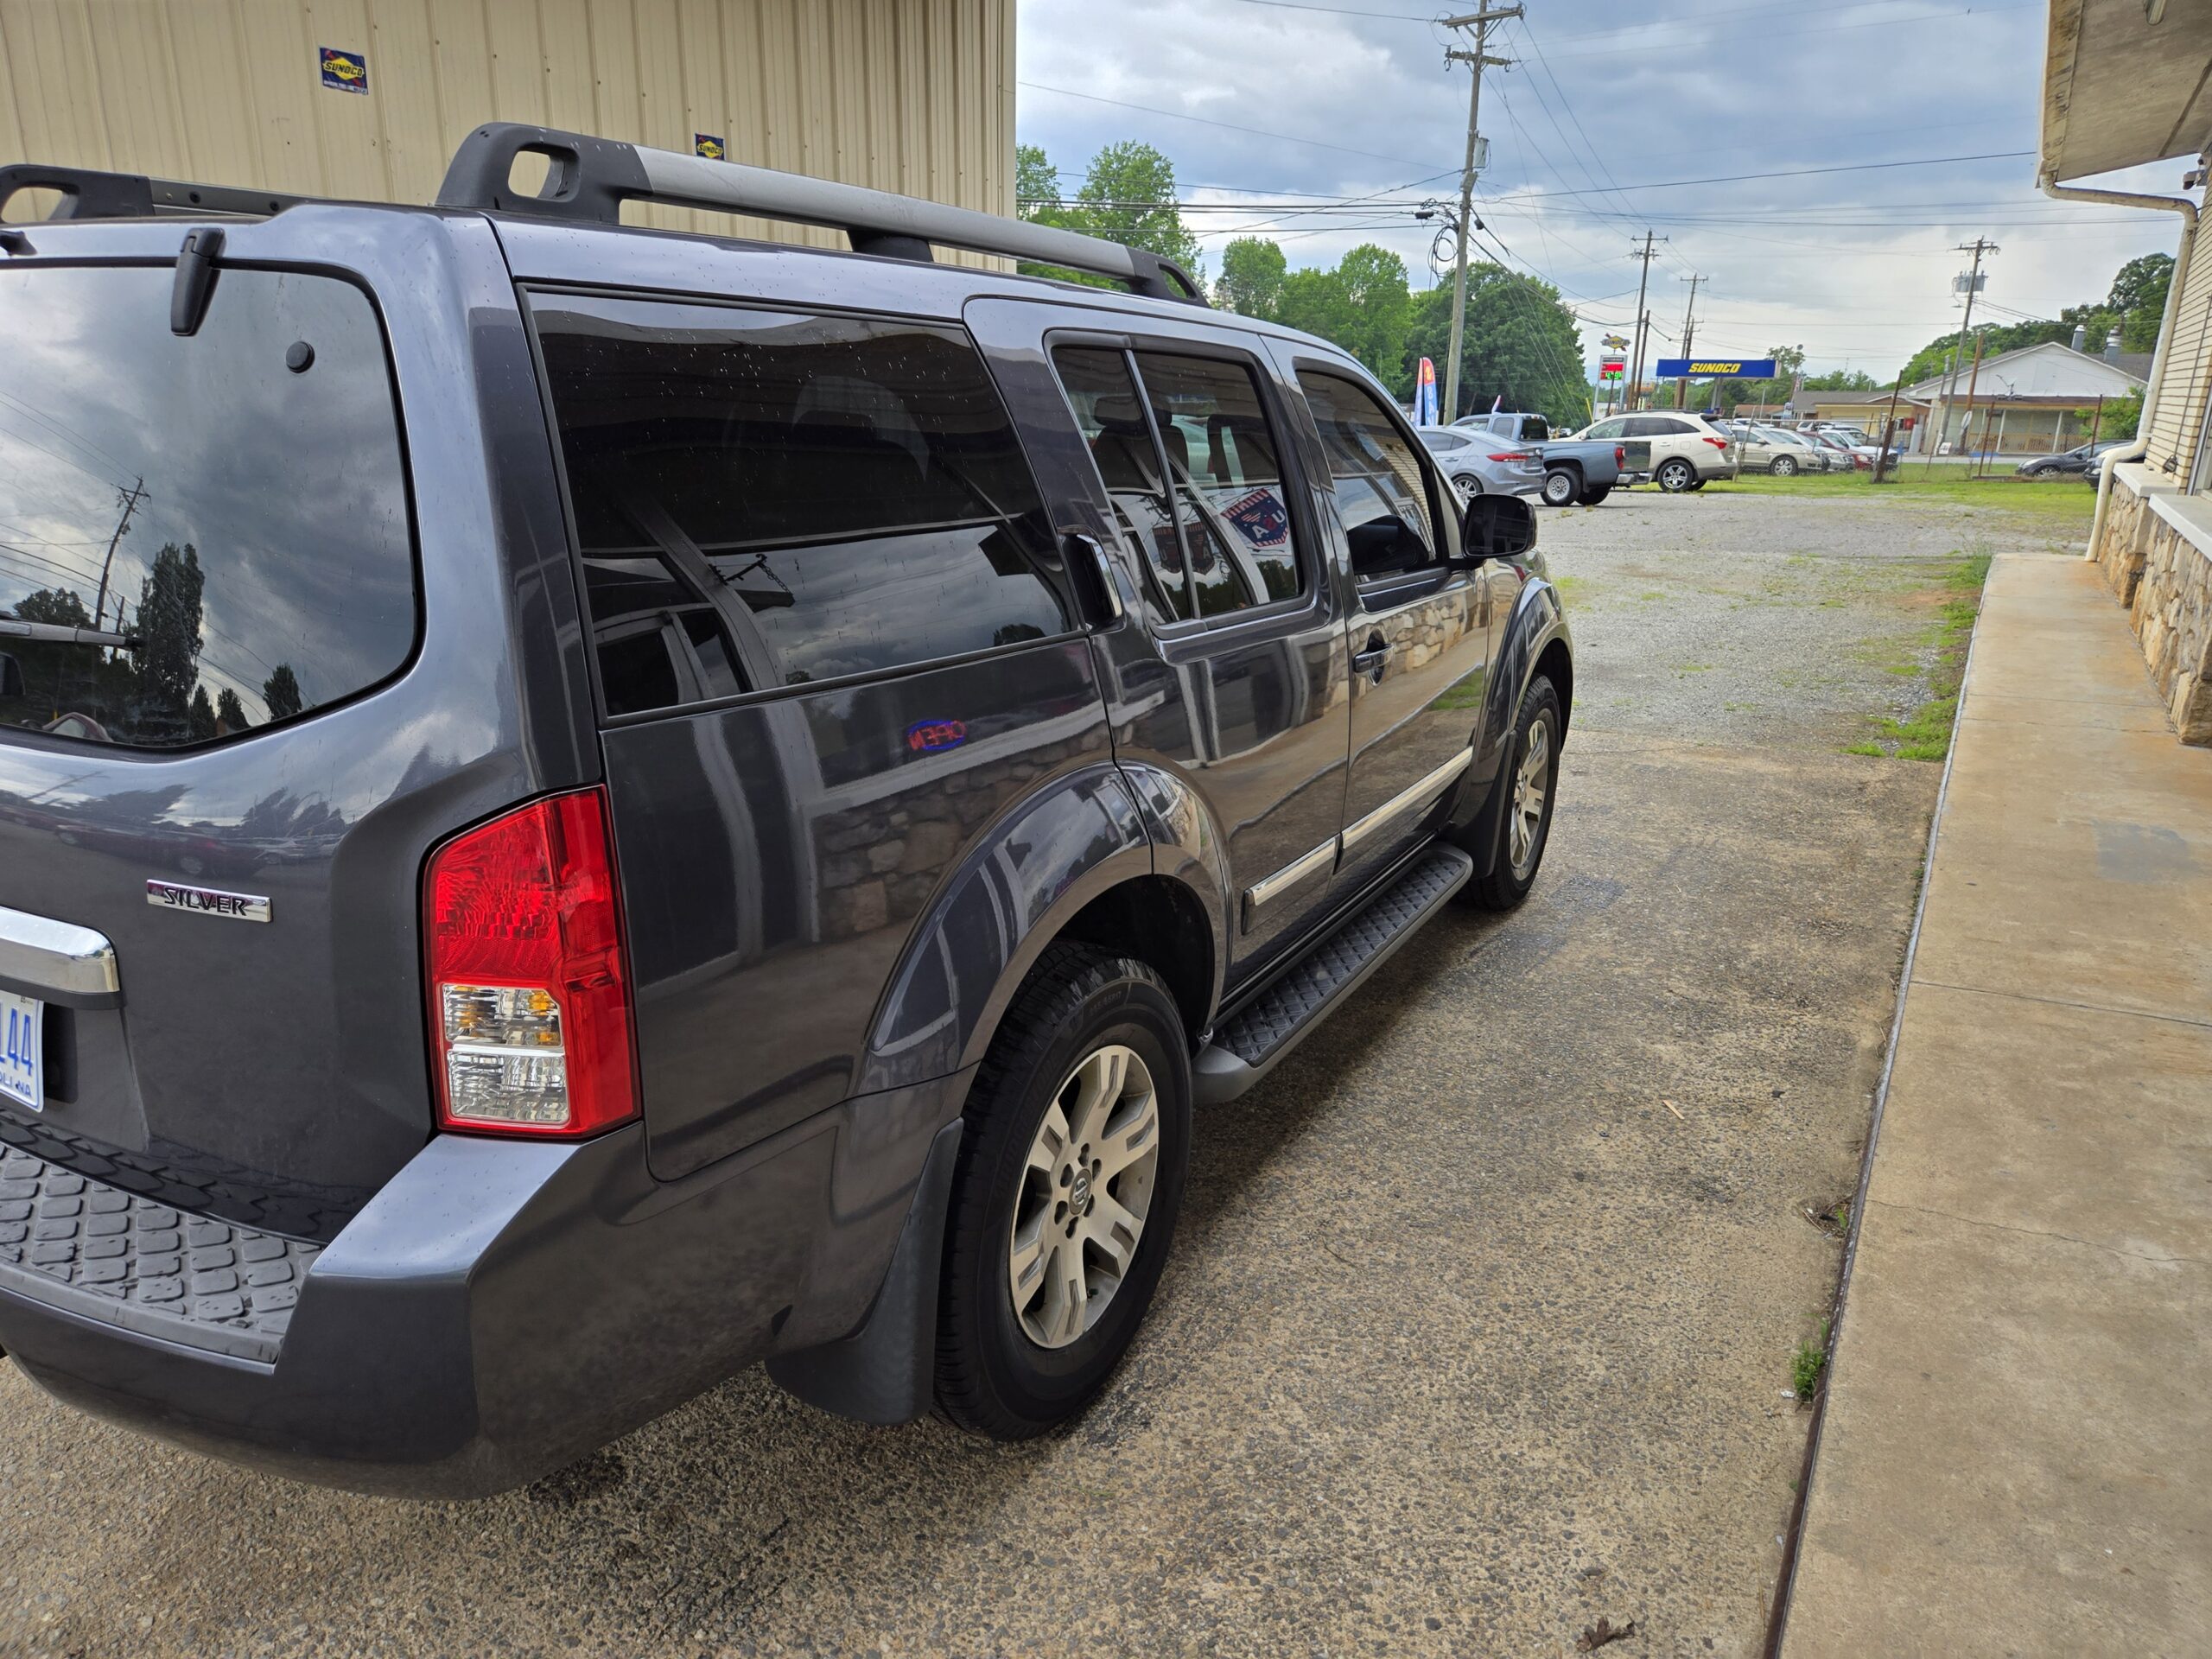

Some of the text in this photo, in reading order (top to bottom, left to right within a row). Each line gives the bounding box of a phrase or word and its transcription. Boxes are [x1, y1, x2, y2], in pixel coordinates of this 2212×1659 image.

[324, 60, 363, 77] SUNOCO
[698, 143, 722, 155] SUNOCO
[1688, 362, 1742, 373] SUNOCO
[164, 887, 247, 917] SILVER
[0, 1007, 33, 1077] 44
